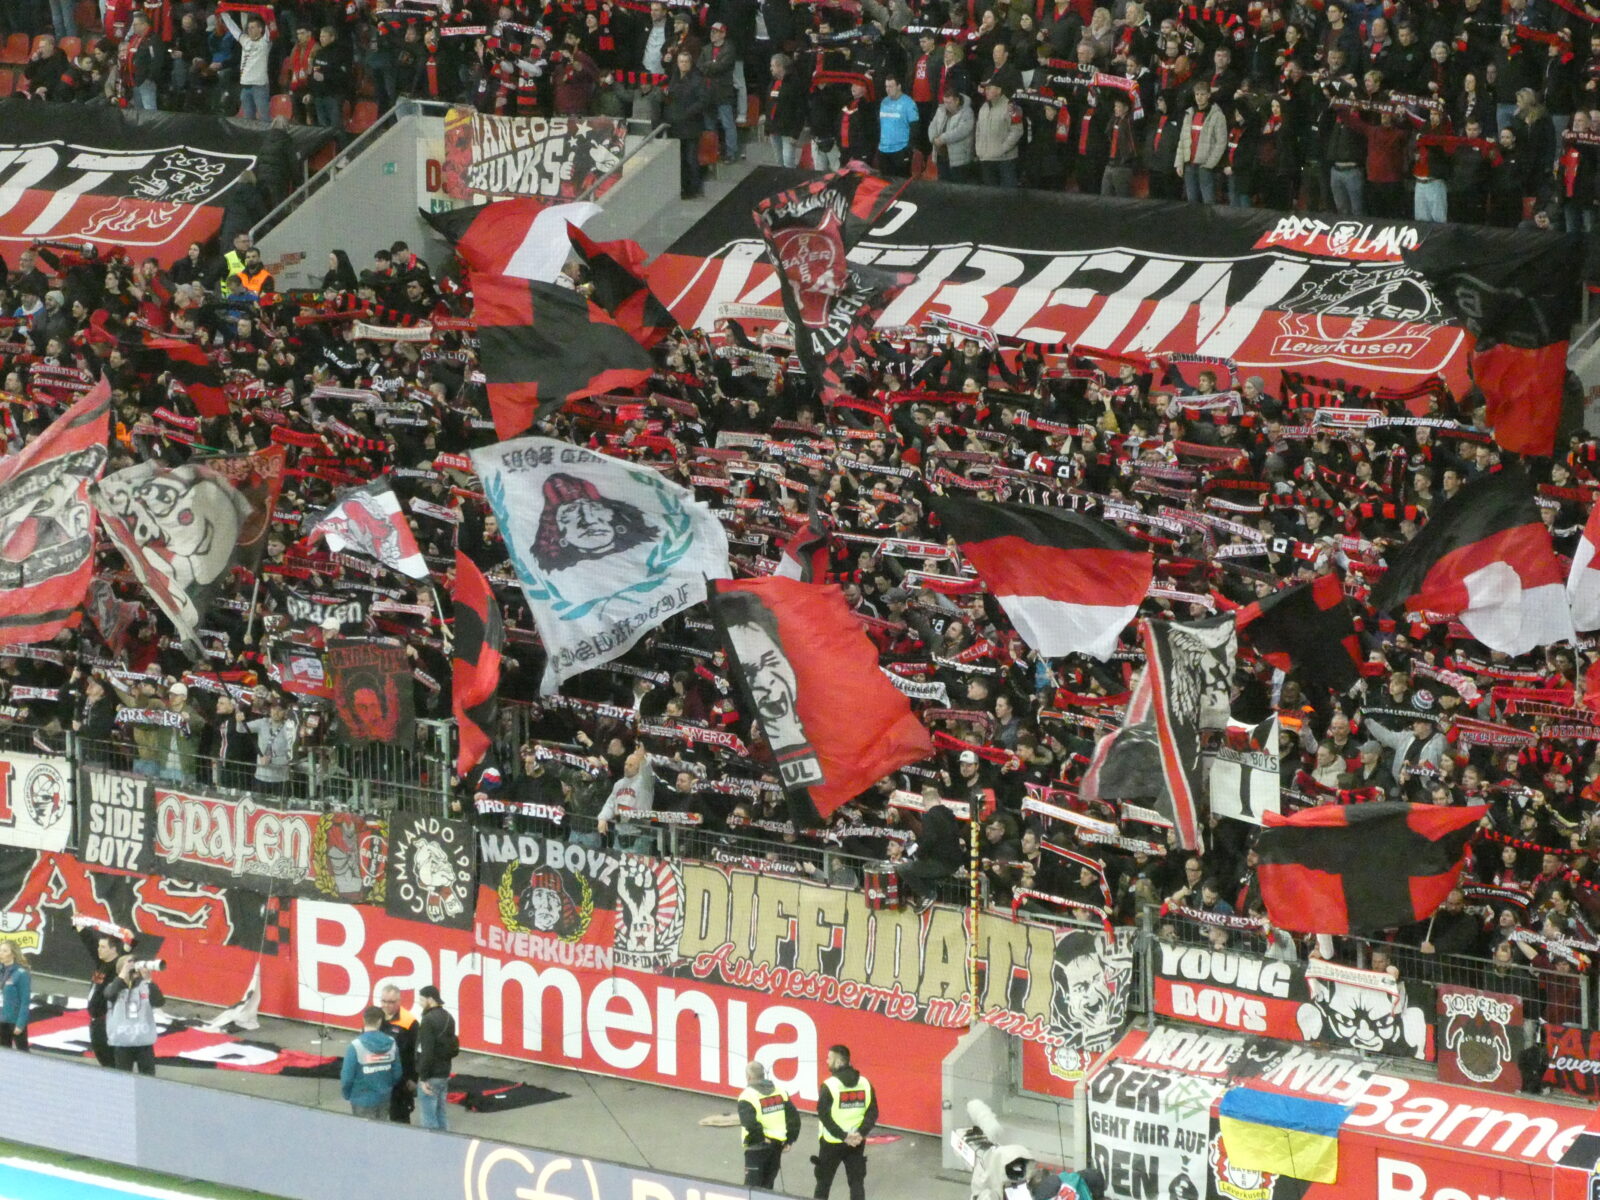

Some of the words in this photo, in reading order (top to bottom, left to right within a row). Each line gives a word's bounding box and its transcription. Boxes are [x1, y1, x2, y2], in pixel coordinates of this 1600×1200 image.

[1280, 339, 1413, 354] Leverkusen
[89, 772, 148, 810] WEST
[782, 763, 814, 783] UL
[90, 804, 144, 840] SIDE
[85, 834, 143, 871] BOYZ
[393, 817, 455, 914] COMMANDO
[452, 844, 471, 899] 1989
[479, 834, 539, 865] MAD
[546, 838, 621, 886] BOYZ
[1181, 906, 1227, 924] YOUNG
[475, 922, 614, 970] LEVERKUSEN
[679, 862, 1056, 1024] DIFFIDATI
[693, 942, 918, 1021] Ausgesperrte
[1159, 942, 1292, 998] YOUNG
[297, 897, 819, 1101] Barmenia
[1171, 984, 1268, 1032] BOYS
[1133, 1025, 1246, 1074] NORD
[1091, 1066, 1171, 1115] DER
[1091, 1111, 1130, 1140] GEHT
[1133, 1120, 1170, 1146] MIR
[1174, 1128, 1207, 1155] AUF
[1093, 1143, 1160, 1199] DEN
